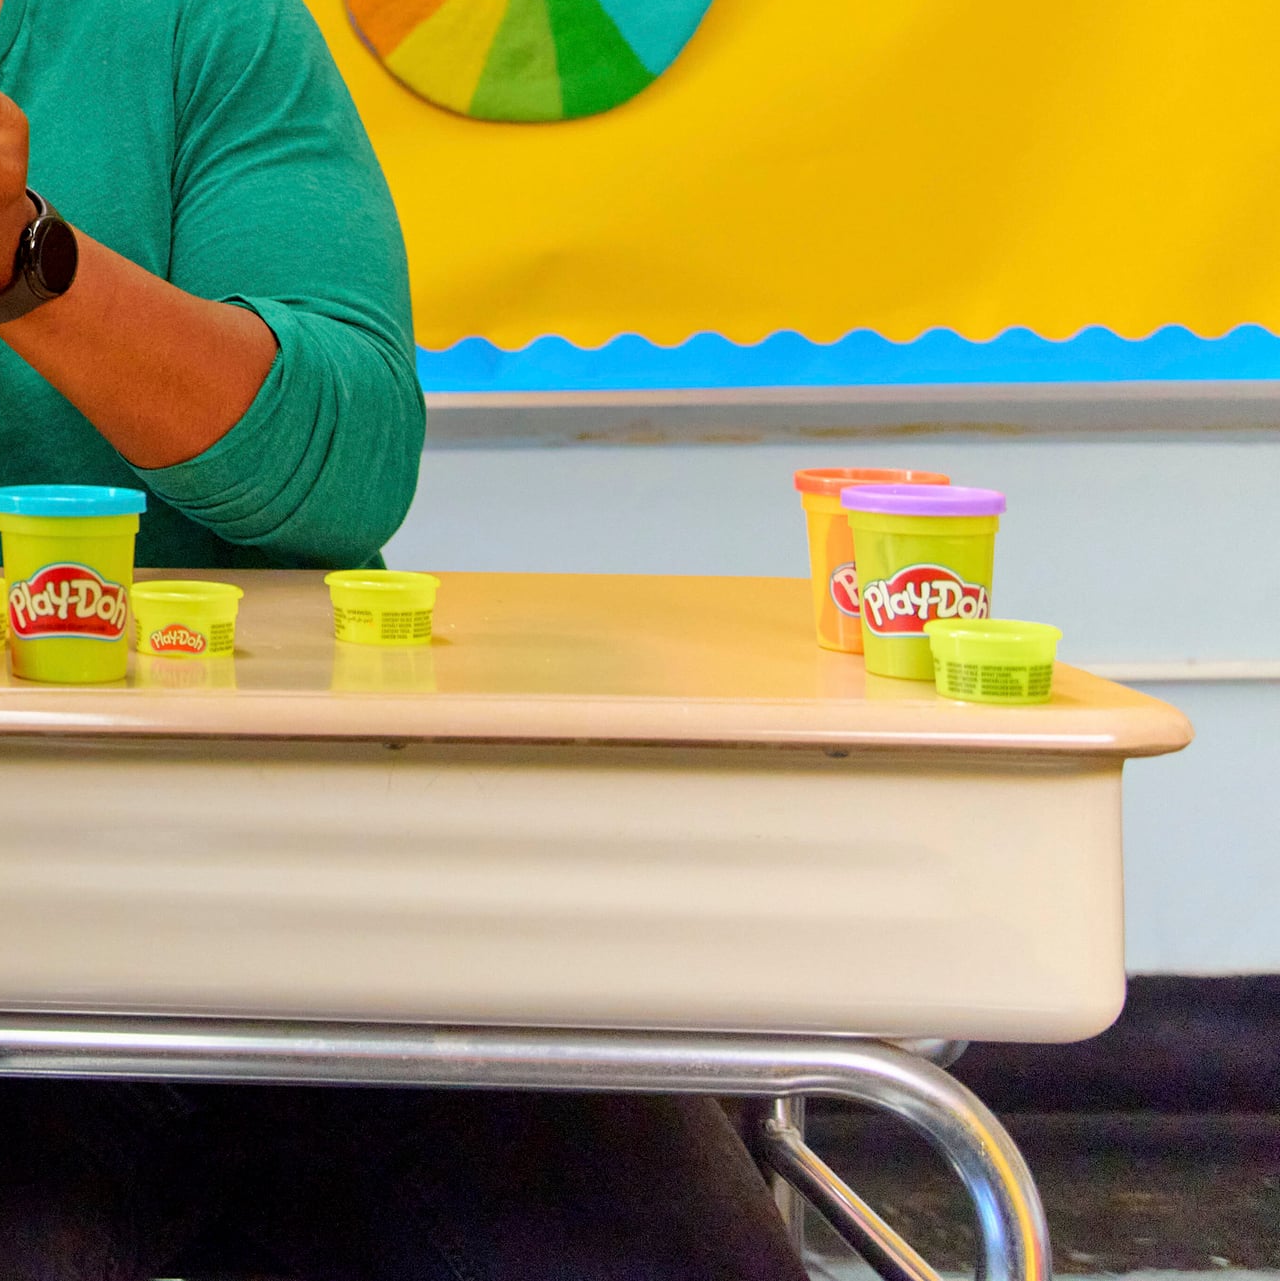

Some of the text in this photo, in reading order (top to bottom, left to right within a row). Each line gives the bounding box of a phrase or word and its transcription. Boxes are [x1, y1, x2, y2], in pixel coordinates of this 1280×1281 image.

[9, 579, 126, 629] Play-Doh
[864, 580, 989, 626] Play-Doh
[151, 630, 204, 651] Play-Doh
